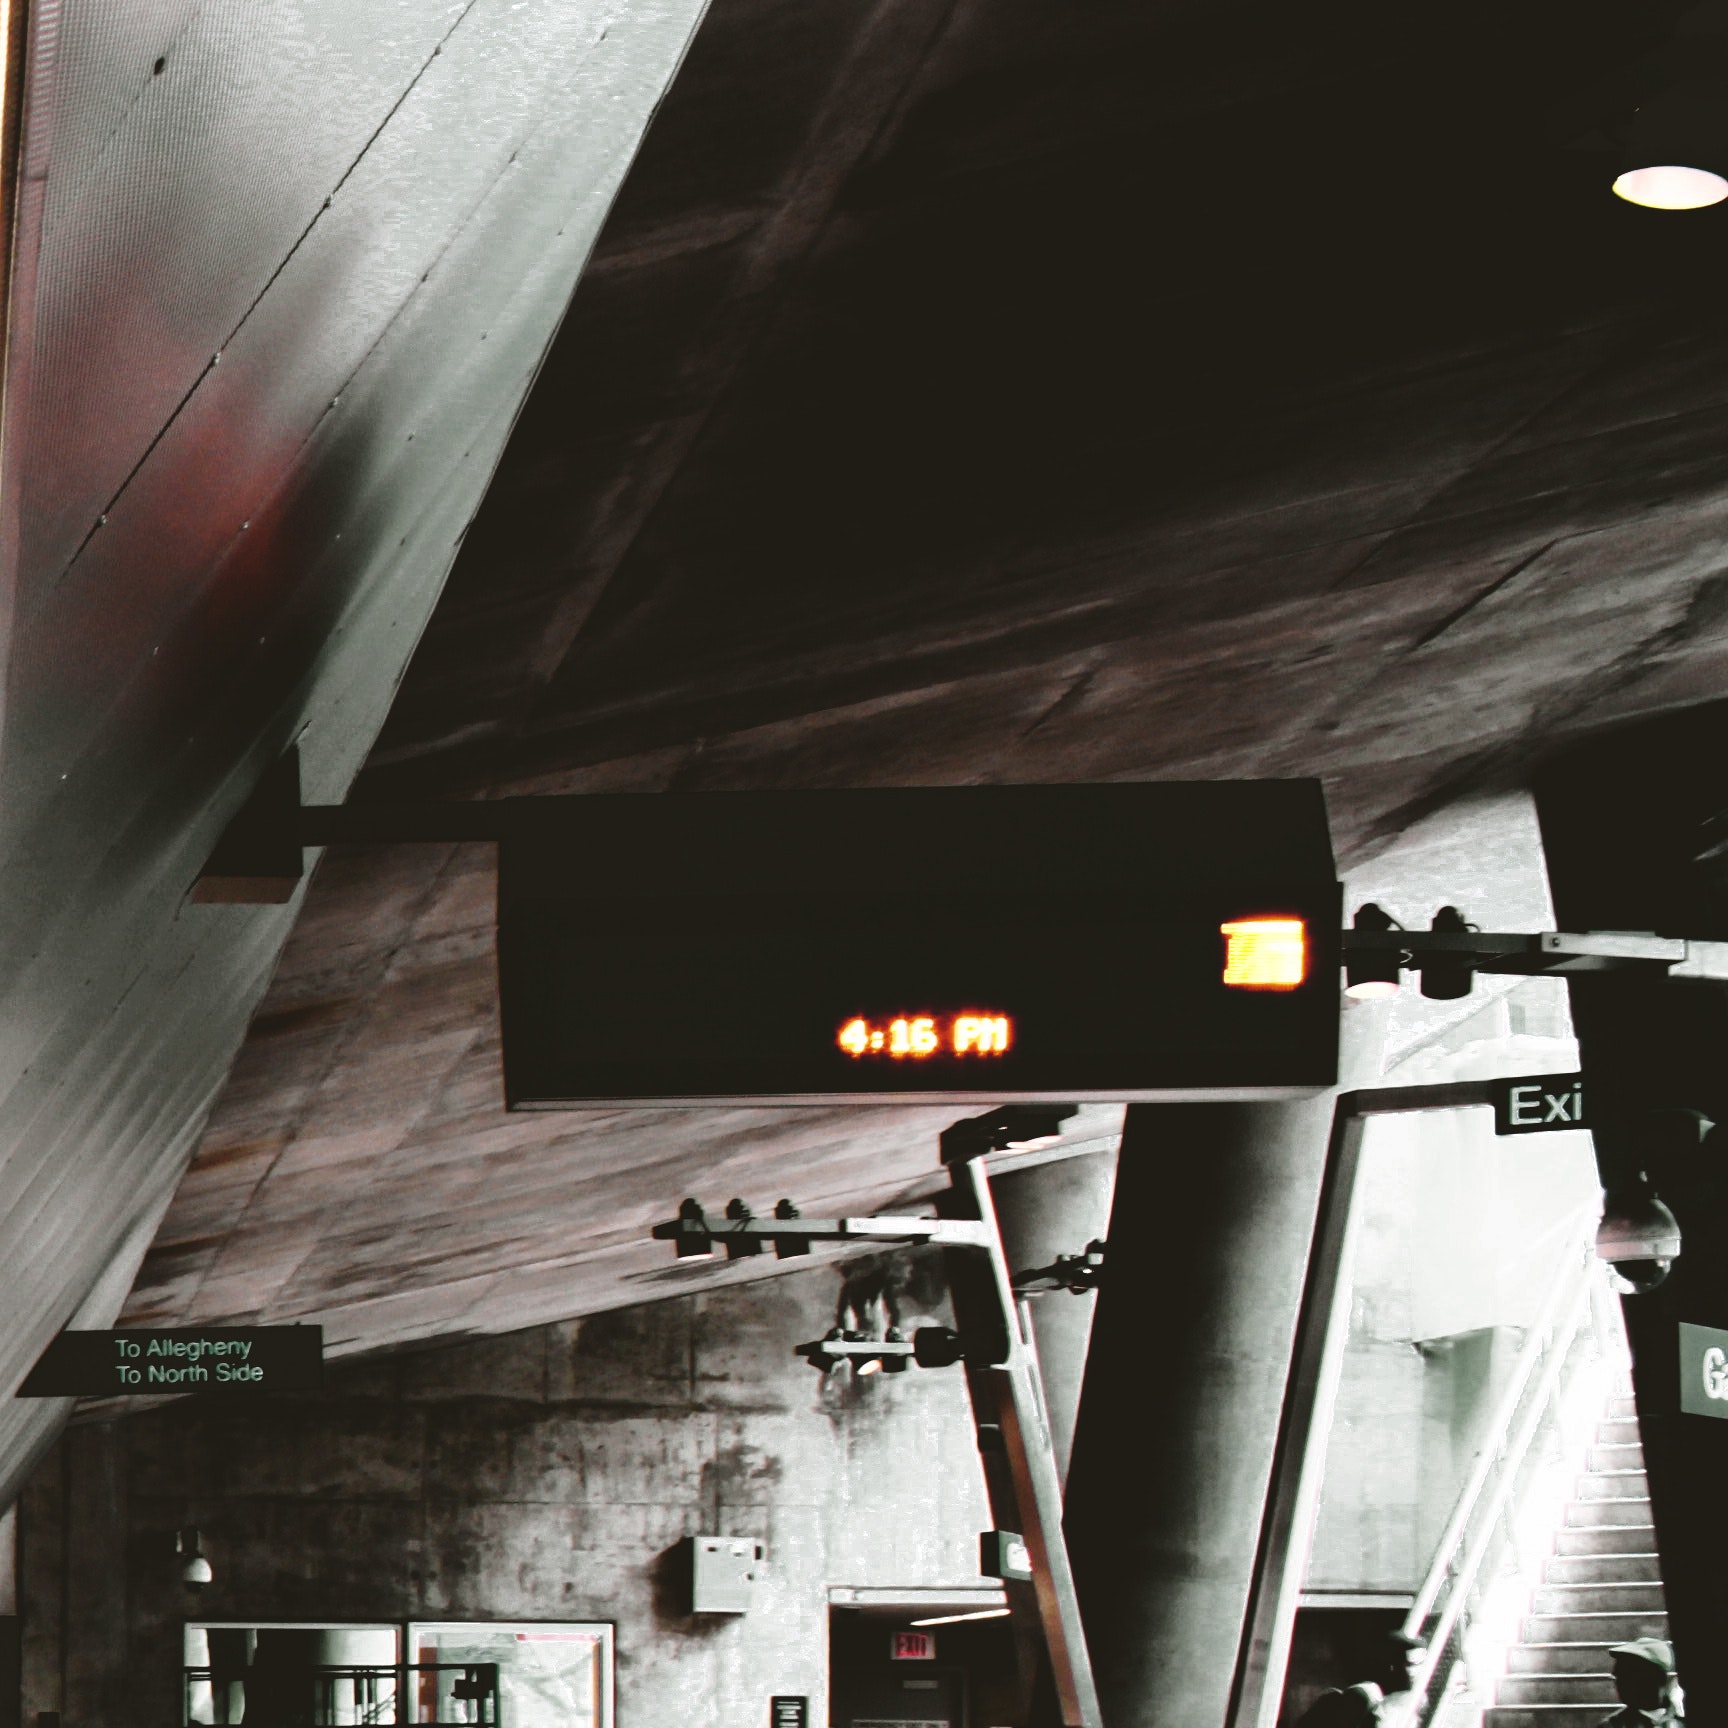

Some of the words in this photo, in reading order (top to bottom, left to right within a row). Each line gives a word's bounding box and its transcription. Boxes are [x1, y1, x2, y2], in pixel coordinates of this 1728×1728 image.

[838, 1017, 939, 1056] 4:16
[953, 1016, 1009, 1053] PM
[115, 1339, 140, 1358] To
[146, 1338, 252, 1361] Allegheny
[115, 1365, 141, 1384] To
[148, 1364, 208, 1383] North
[216, 1363, 264, 1382] Side
